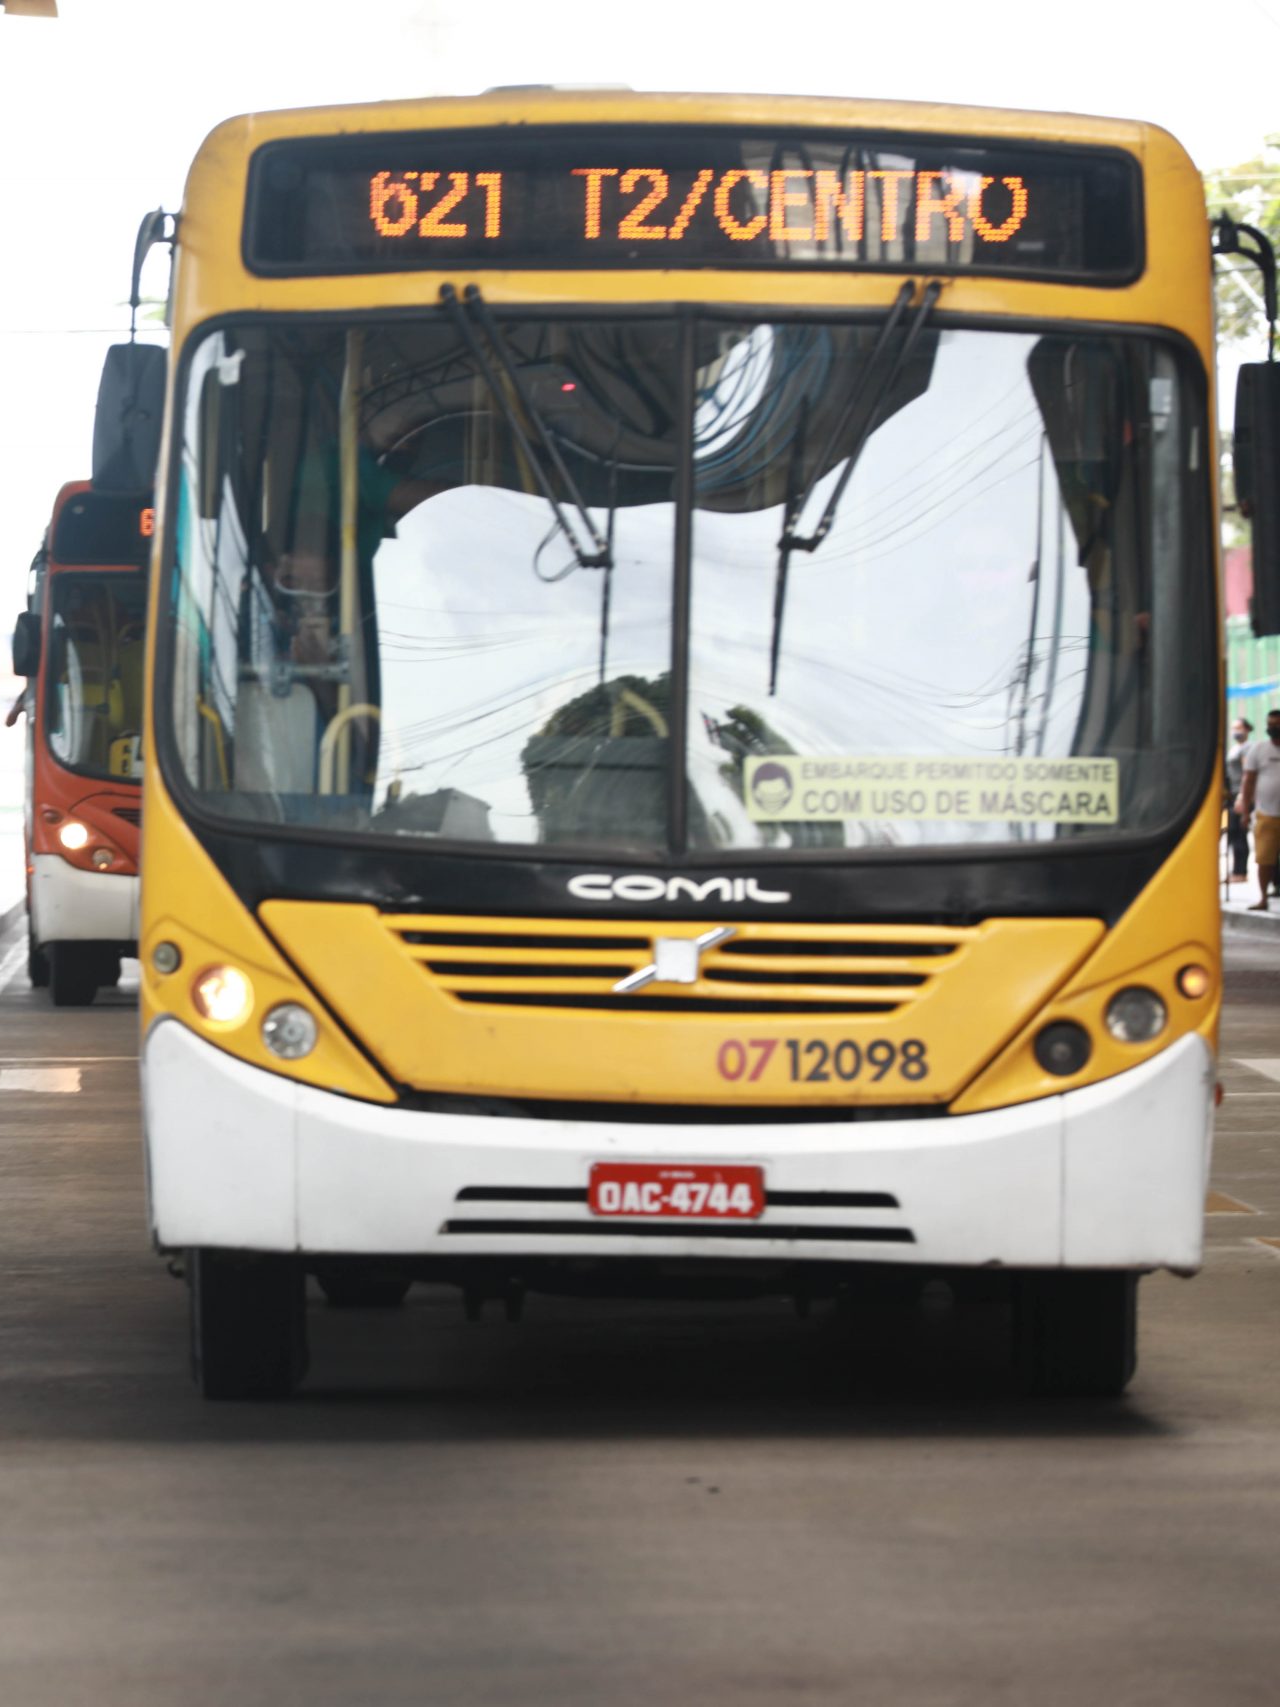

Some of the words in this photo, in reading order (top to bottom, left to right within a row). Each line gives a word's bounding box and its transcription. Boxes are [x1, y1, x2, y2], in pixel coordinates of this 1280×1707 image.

[369, 170, 502, 238] 621
[570, 167, 1027, 242] T2/CENTRO
[801, 762, 909, 781] EMBARQUE
[915, 763, 1018, 782] PERMITIDO
[1023, 764, 1114, 782] SOMENTE
[801, 790, 862, 814] COM
[872, 790, 926, 815] USO
[936, 791, 971, 815] DE
[980, 785, 1112, 817] MÁSCARA
[568, 873, 791, 903] COMIL
[598, 1181, 754, 1213] OAC-4744
